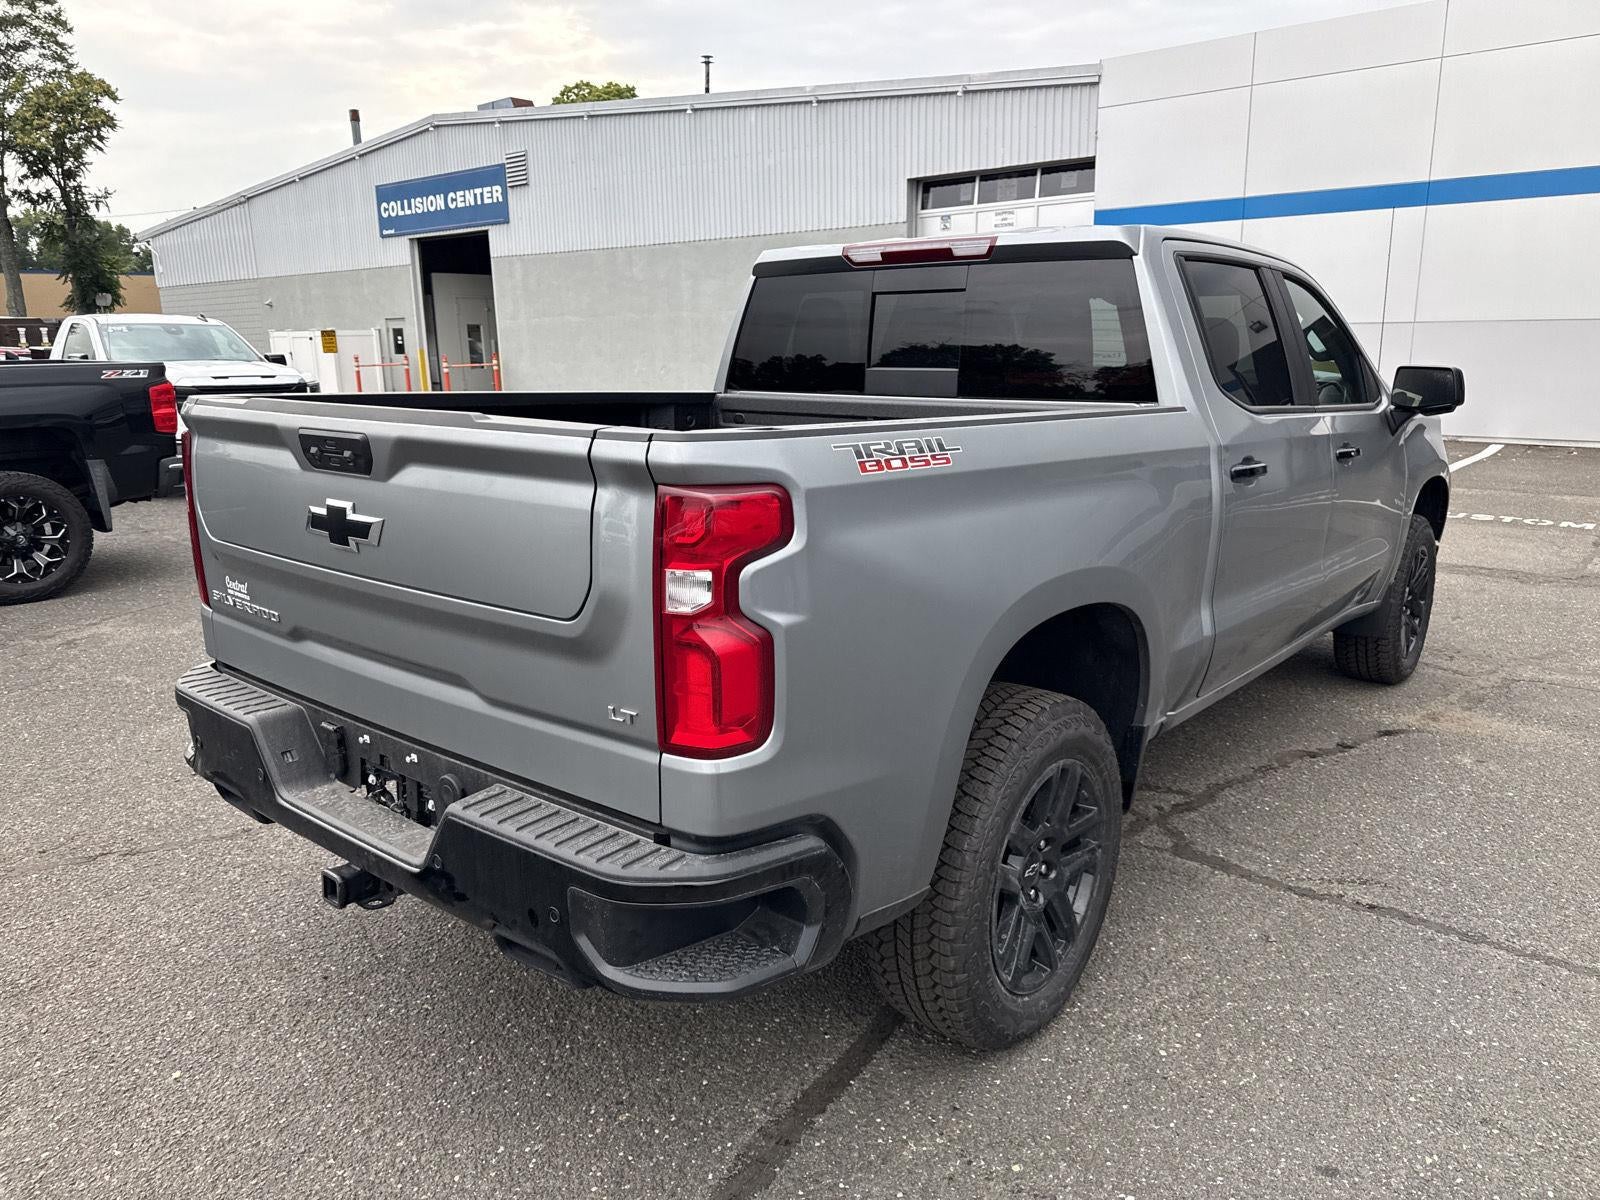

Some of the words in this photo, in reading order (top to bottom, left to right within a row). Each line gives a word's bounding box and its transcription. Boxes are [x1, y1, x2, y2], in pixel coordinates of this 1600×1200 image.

[380, 193, 445, 218] COLLISION
[447, 184, 503, 210] CENTER
[101, 369, 149, 379] Z71
[831, 436, 962, 460] TRAIL
[857, 452, 952, 475] BOSS
[225, 575, 248, 594] Central
[212, 589, 281, 622] SILVERADO
[607, 705, 638, 725] LT
